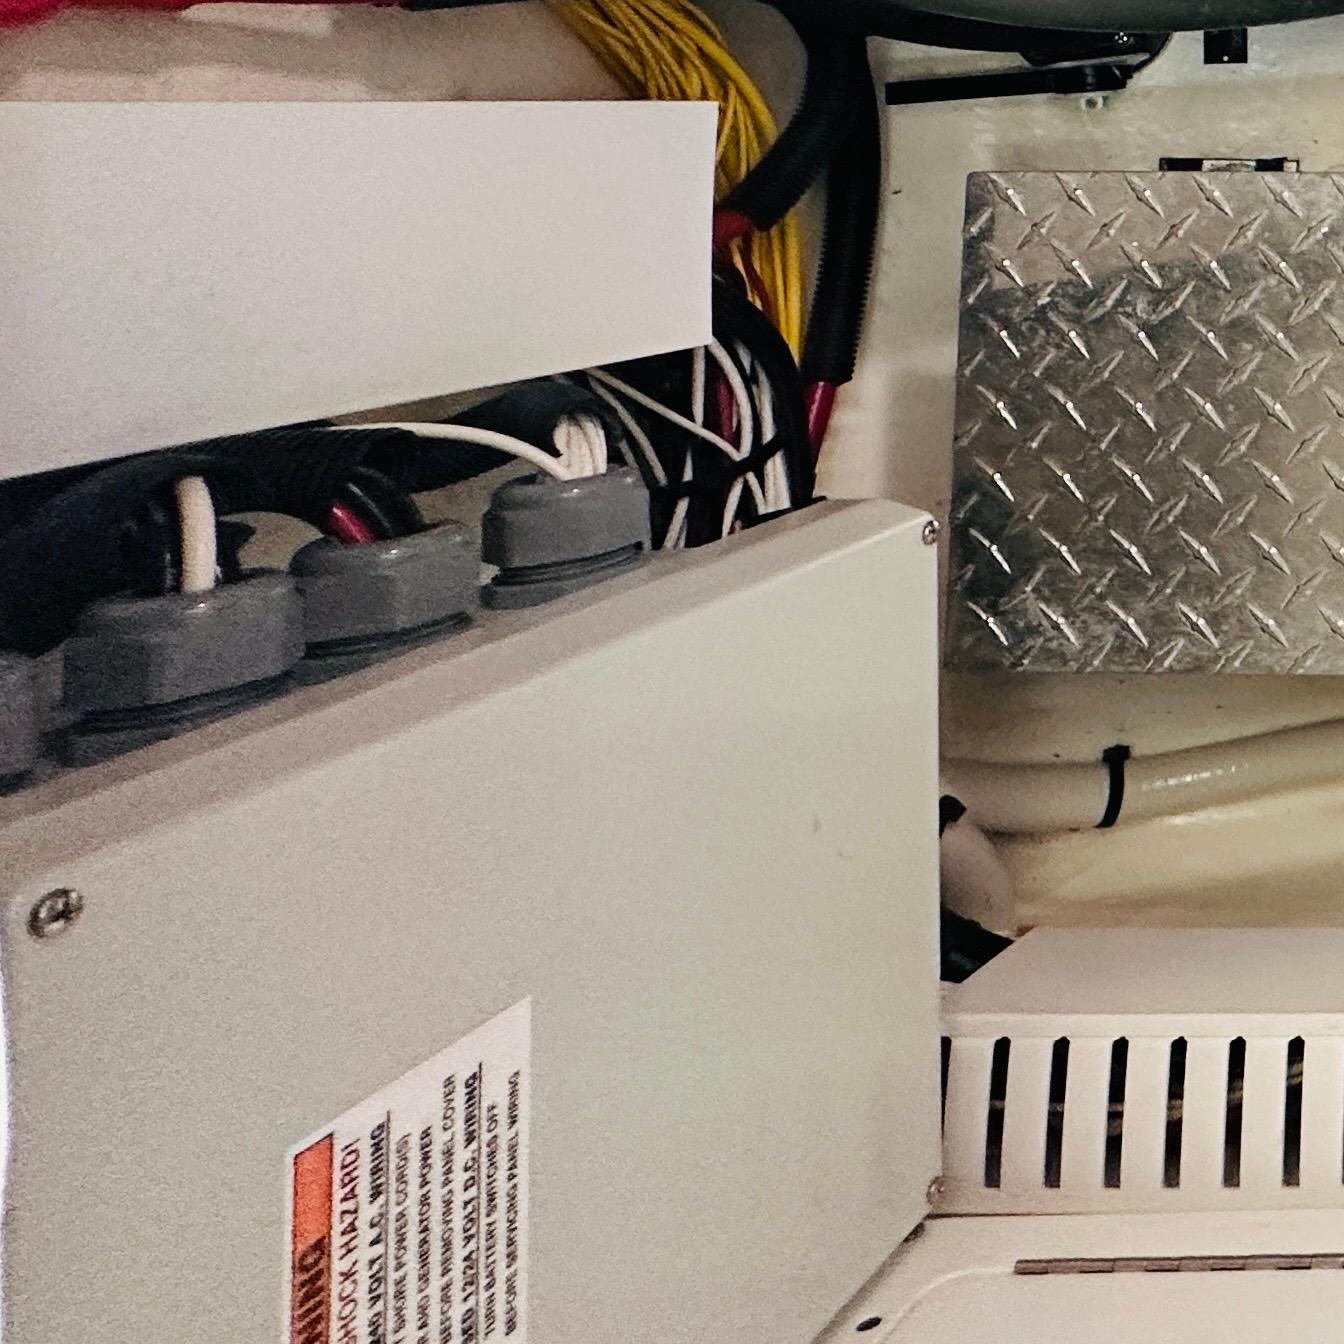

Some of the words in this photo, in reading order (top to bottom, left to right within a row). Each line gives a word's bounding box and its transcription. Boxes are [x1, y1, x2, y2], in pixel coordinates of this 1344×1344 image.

[443, 1073, 455, 1130] COVER
[464, 1072, 477, 1148] WIRING
[487, 1102, 497, 1131] OFF
[508, 1069, 520, 1128] WIRING
[369, 1121, 385, 1200] WIRING
[396, 1132, 410, 1205] CORD(S)
[419, 1125, 432, 1186] POWER
[442, 1132, 455, 1185] PANEL
[464, 1149, 477, 1187] D.C.
[486, 1135, 497, 1215] SWITCHES
[507, 1130, 519, 1180] PANEL
[339, 1137, 360, 1259] HAZARD!
[369, 1204, 383, 1245] A.C.
[463, 1192, 476, 1243] VOLT
[506, 1181, 518, 1267] SERVICING
[396, 1209, 408, 1268] POWER
[418, 1191, 431, 1290] GENERATOR
[441, 1190, 454, 1274] REMOVING
[486, 1221, 497, 1288] BATTERY
[368, 1254, 383, 1307] VOLT
[395, 1273, 406, 1333] SHORE
[463, 1250, 475, 1301] 12/24
[506, 1269, 517, 1335] BEFORE
[418, 1295, 430, 1329] AND
[485, 1293, 495, 1336] TURN
